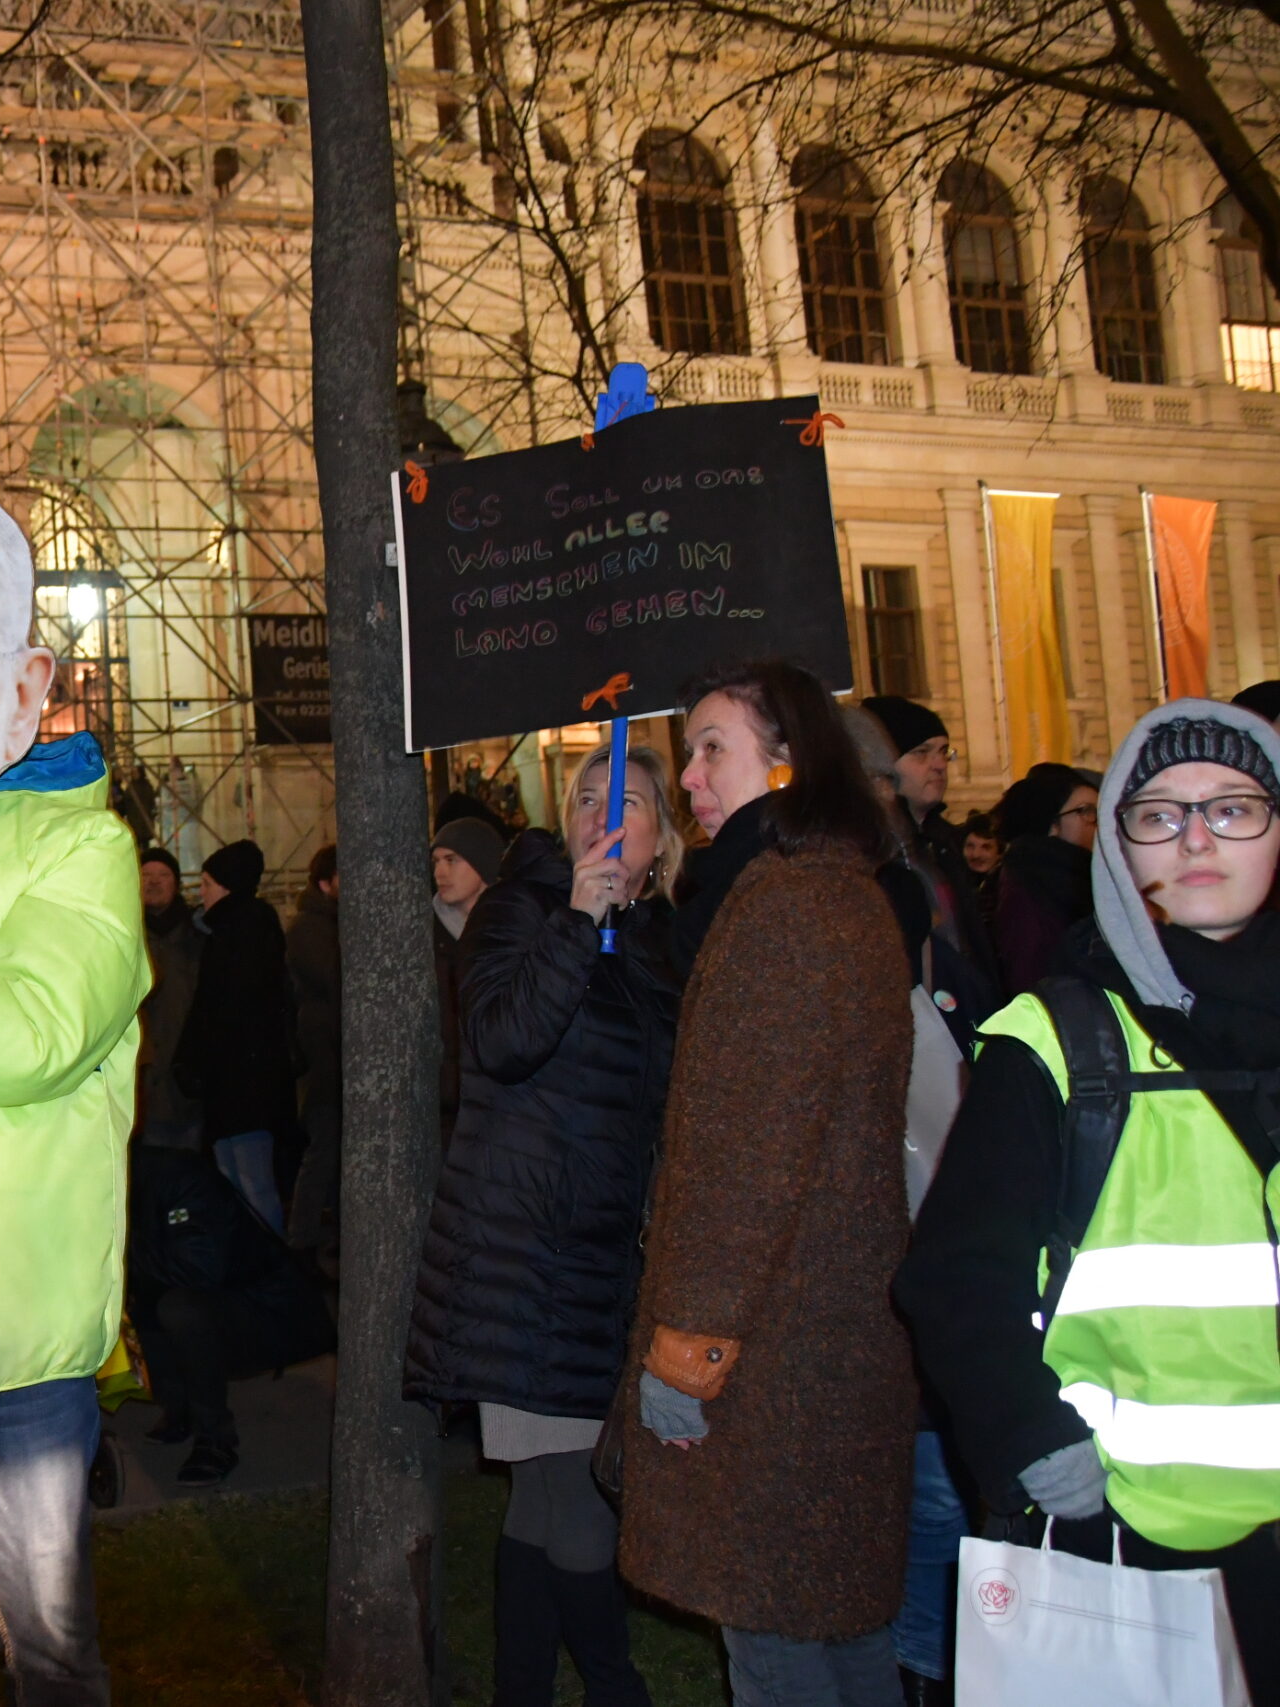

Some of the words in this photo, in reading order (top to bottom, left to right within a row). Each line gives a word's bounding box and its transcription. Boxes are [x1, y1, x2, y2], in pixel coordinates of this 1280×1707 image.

[641, 472, 683, 494] UM
[564, 510, 670, 551] ALLER
[452, 542, 659, 616] MENSCHEN
[679, 542, 732, 570] IM
[253, 618, 330, 647] Meidli
[455, 620, 558, 658] LAND
[283, 655, 330, 679] Gerüs
